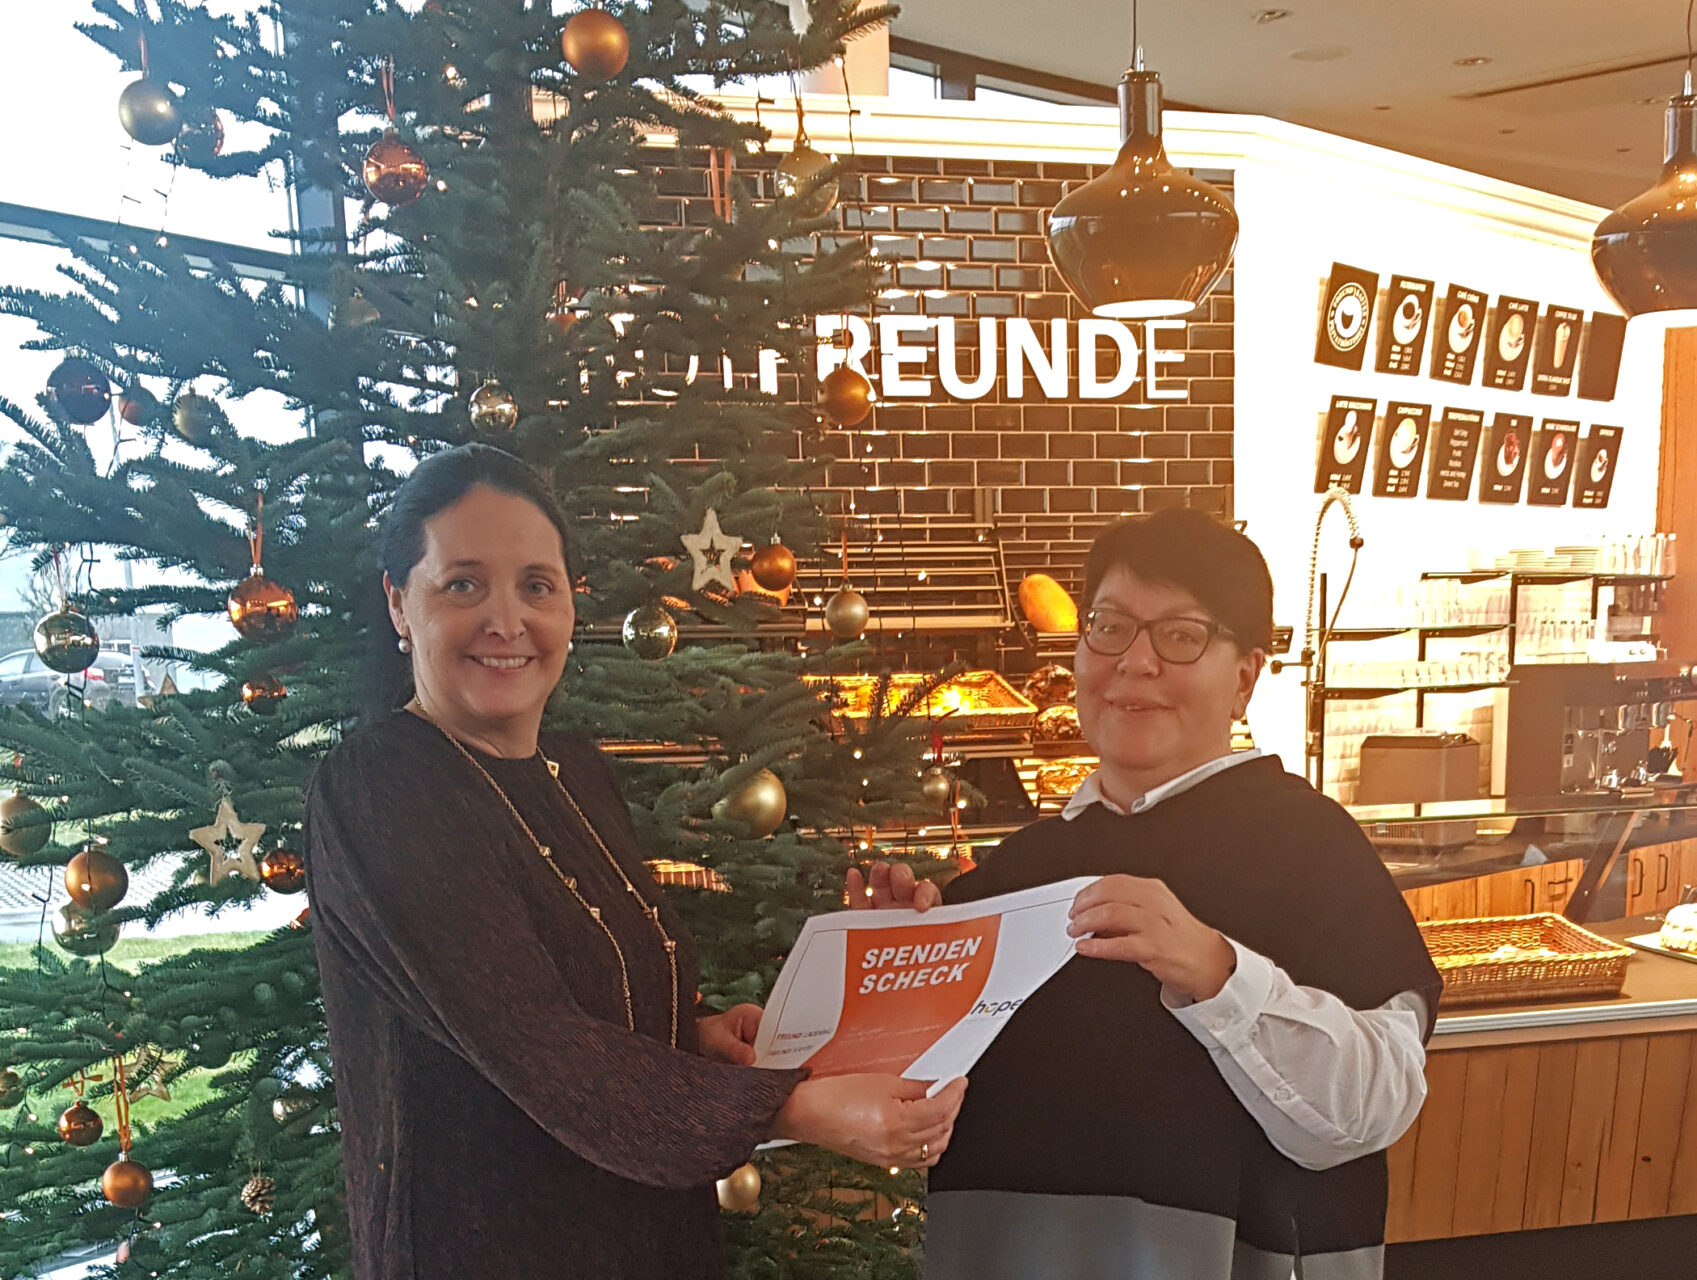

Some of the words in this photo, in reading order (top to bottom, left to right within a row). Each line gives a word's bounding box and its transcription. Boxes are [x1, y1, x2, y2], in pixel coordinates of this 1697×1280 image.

[861, 936, 983, 969] SPENDEN
[859, 962, 970, 995] SCHECK
[970, 998, 1023, 1016] hope
